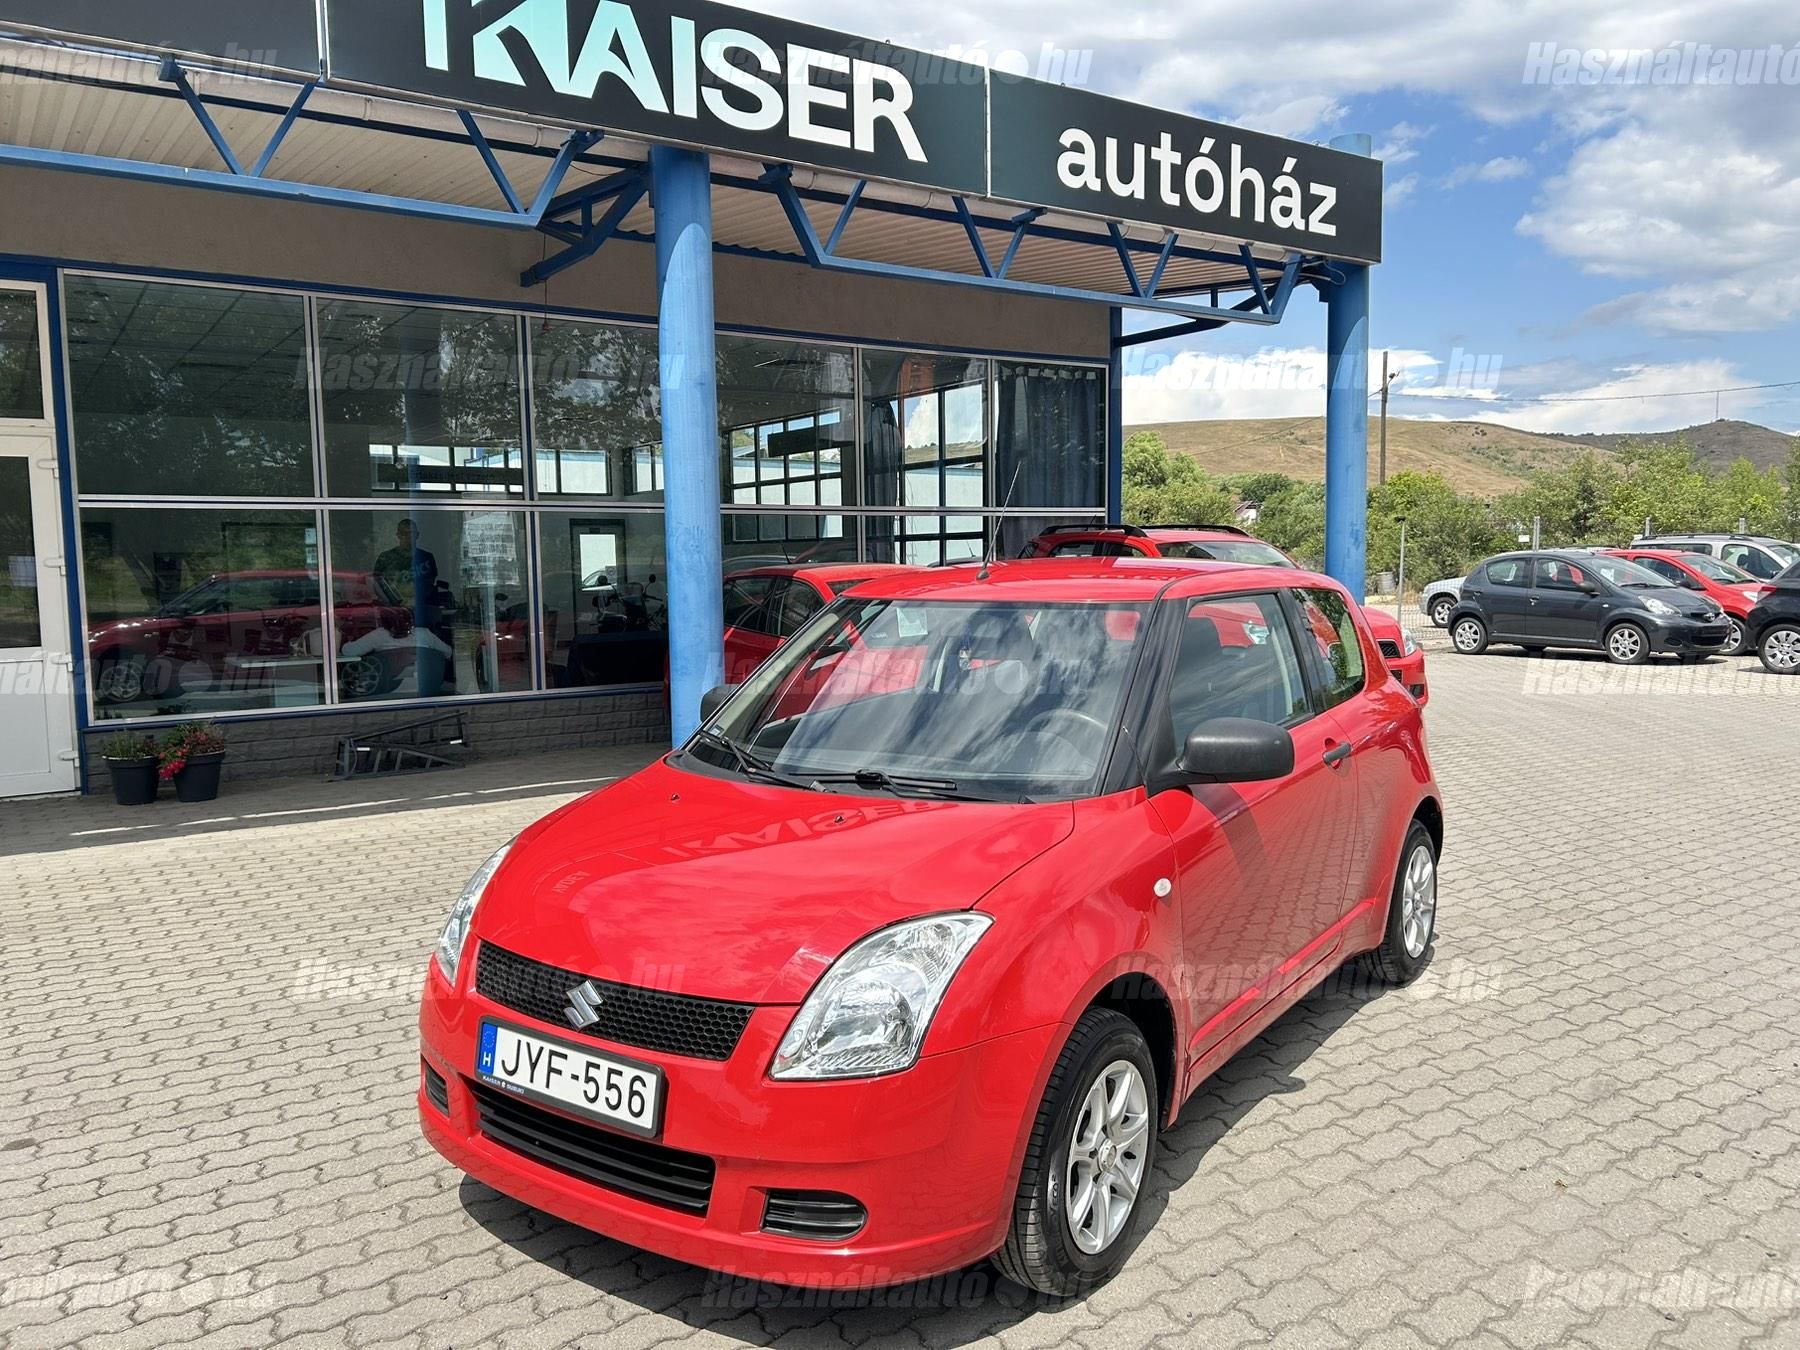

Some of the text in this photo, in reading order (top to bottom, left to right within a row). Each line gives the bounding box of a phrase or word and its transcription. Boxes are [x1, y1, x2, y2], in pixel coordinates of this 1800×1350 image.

[422, 0, 929, 163] KAISER
[1055, 127, 1338, 237] autóház
[481, 1038, 648, 1119] H JYF-556
